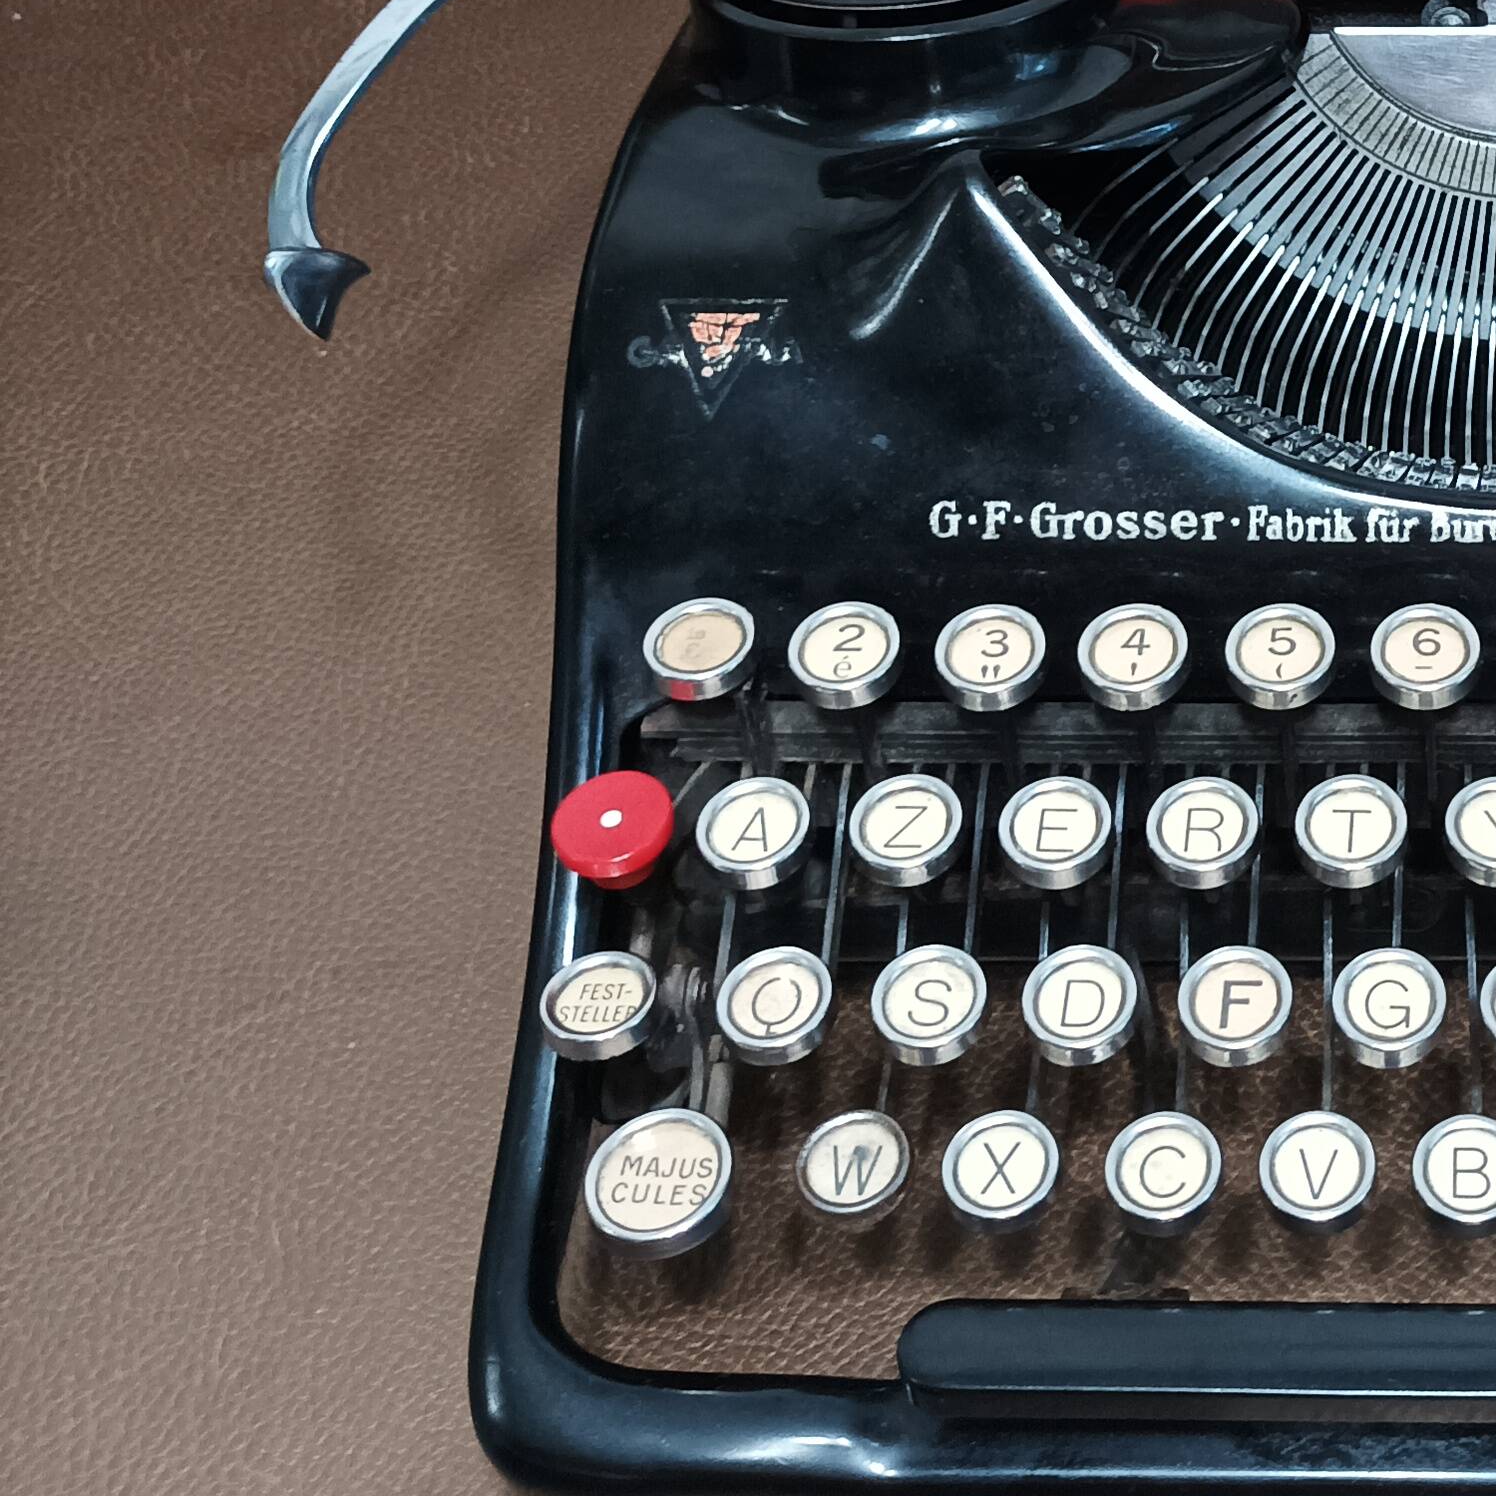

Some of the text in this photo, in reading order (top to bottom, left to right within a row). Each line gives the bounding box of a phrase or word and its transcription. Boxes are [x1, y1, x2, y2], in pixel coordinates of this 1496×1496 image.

[1365, 508, 1419, 542] für
[831, 624, 866, 653] 2
[979, 629, 1010, 658] 3
[1120, 628, 1151, 656] 4
[1267, 626, 1297, 657] 5
[1411, 628, 1442, 657] 6
[833, 656, 853, 679] é
[1275, 662, 1284, 680] (
[731, 806, 769, 853] A
[882, 805, 928, 848] Z
[1034, 807, 1079, 854] E
[1183, 807, 1224, 853] R
[1331, 809, 1373, 854] T
[578, 983, 633, 1002] FEST-
[751, 976, 801, 1036] Q
[907, 979, 953, 1028] S
[1060, 979, 1105, 1028] D
[1218, 979, 1264, 1030] F
[1364, 979, 1411, 1030] G
[619, 1155, 714, 1180] MAJUS
[832, 1144, 883, 1197] W
[979, 1140, 1022, 1195] X
[1138, 1144, 1188, 1199] C
[1298, 1148, 1339, 1201] V
[1451, 1146, 1492, 1199] B
[610, 1181, 709, 1206] CULES
